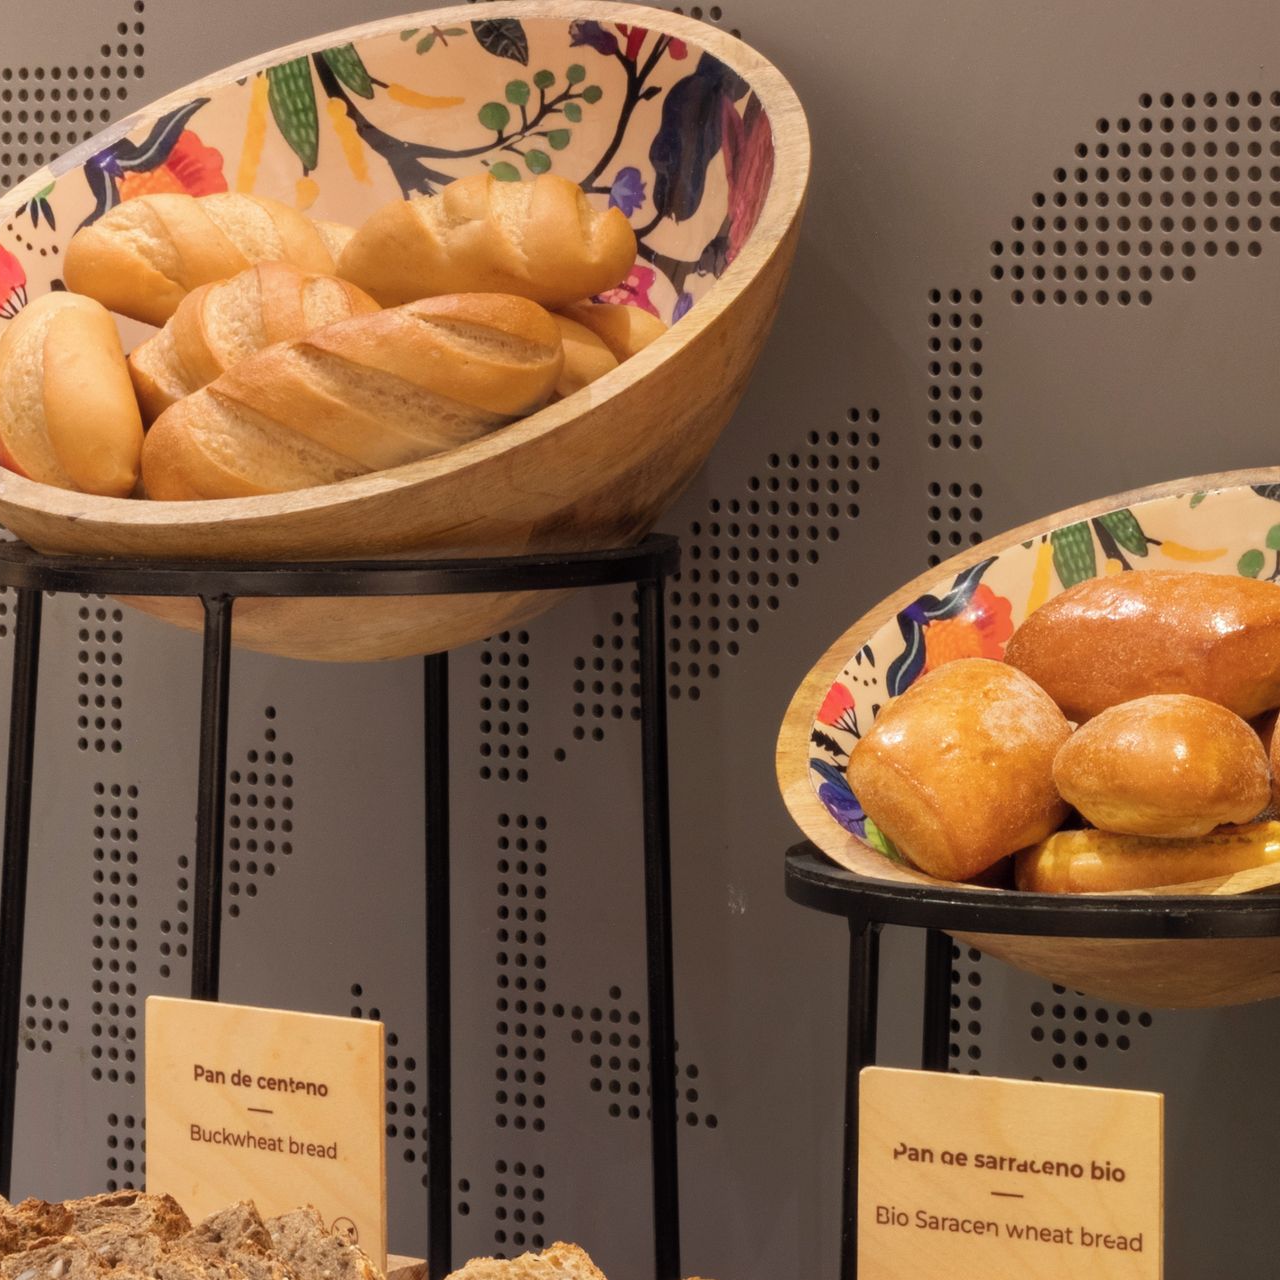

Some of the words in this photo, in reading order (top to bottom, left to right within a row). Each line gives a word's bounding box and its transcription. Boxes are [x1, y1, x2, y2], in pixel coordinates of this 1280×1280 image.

[193, 1064, 226, 1085] Pan
[231, 1069, 252, 1088] de
[257, 1076, 329, 1097] centeno
[190, 1123, 284, 1153] Buckwheat
[288, 1136, 338, 1160] bread
[1090, 1160, 1127, 1183] bio
[875, 1204, 910, 1227] Bio
[914, 1209, 1000, 1238] Saracen
[1079, 1226, 1144, 1254] bread
